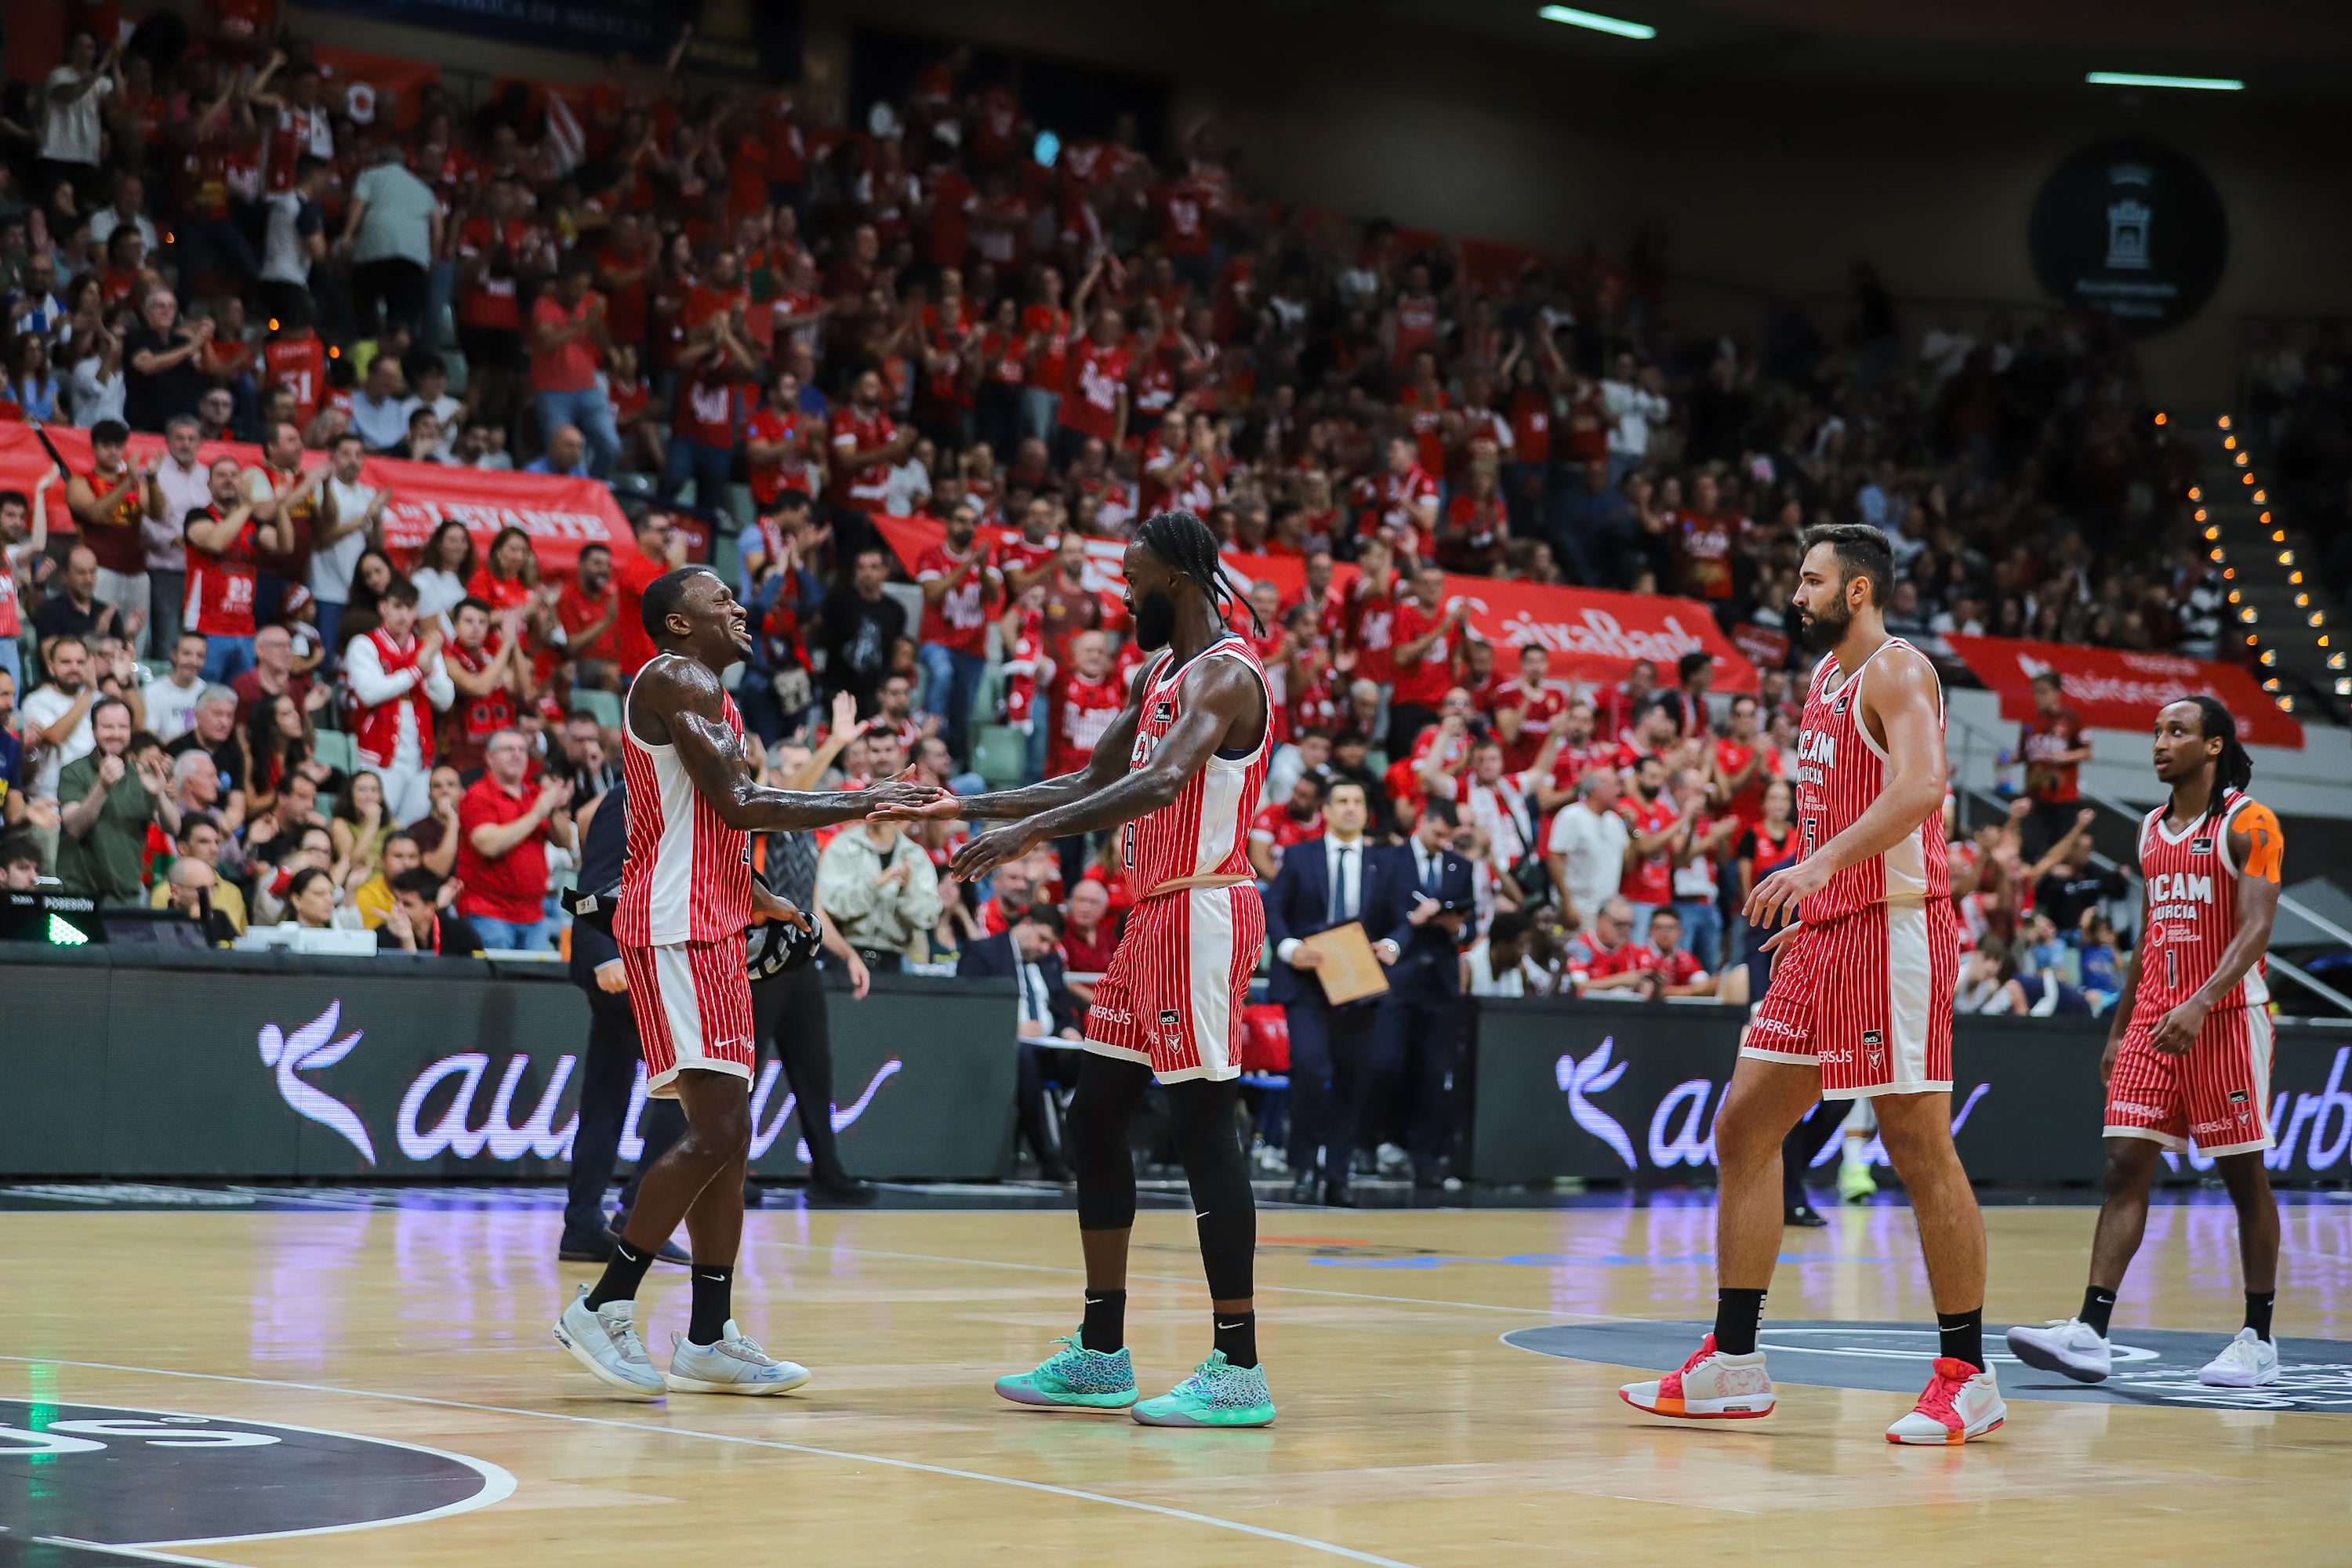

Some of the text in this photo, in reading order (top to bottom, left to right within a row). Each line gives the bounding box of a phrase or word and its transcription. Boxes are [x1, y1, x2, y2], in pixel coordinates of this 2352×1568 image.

[422, 500, 612, 541] LEVANTE
[1124, 822, 1135, 869] 8
[2165, 949, 2176, 989] 1
[1161, 1014, 1175, 1024] acb
[1864, 1034, 1878, 1044] acb
